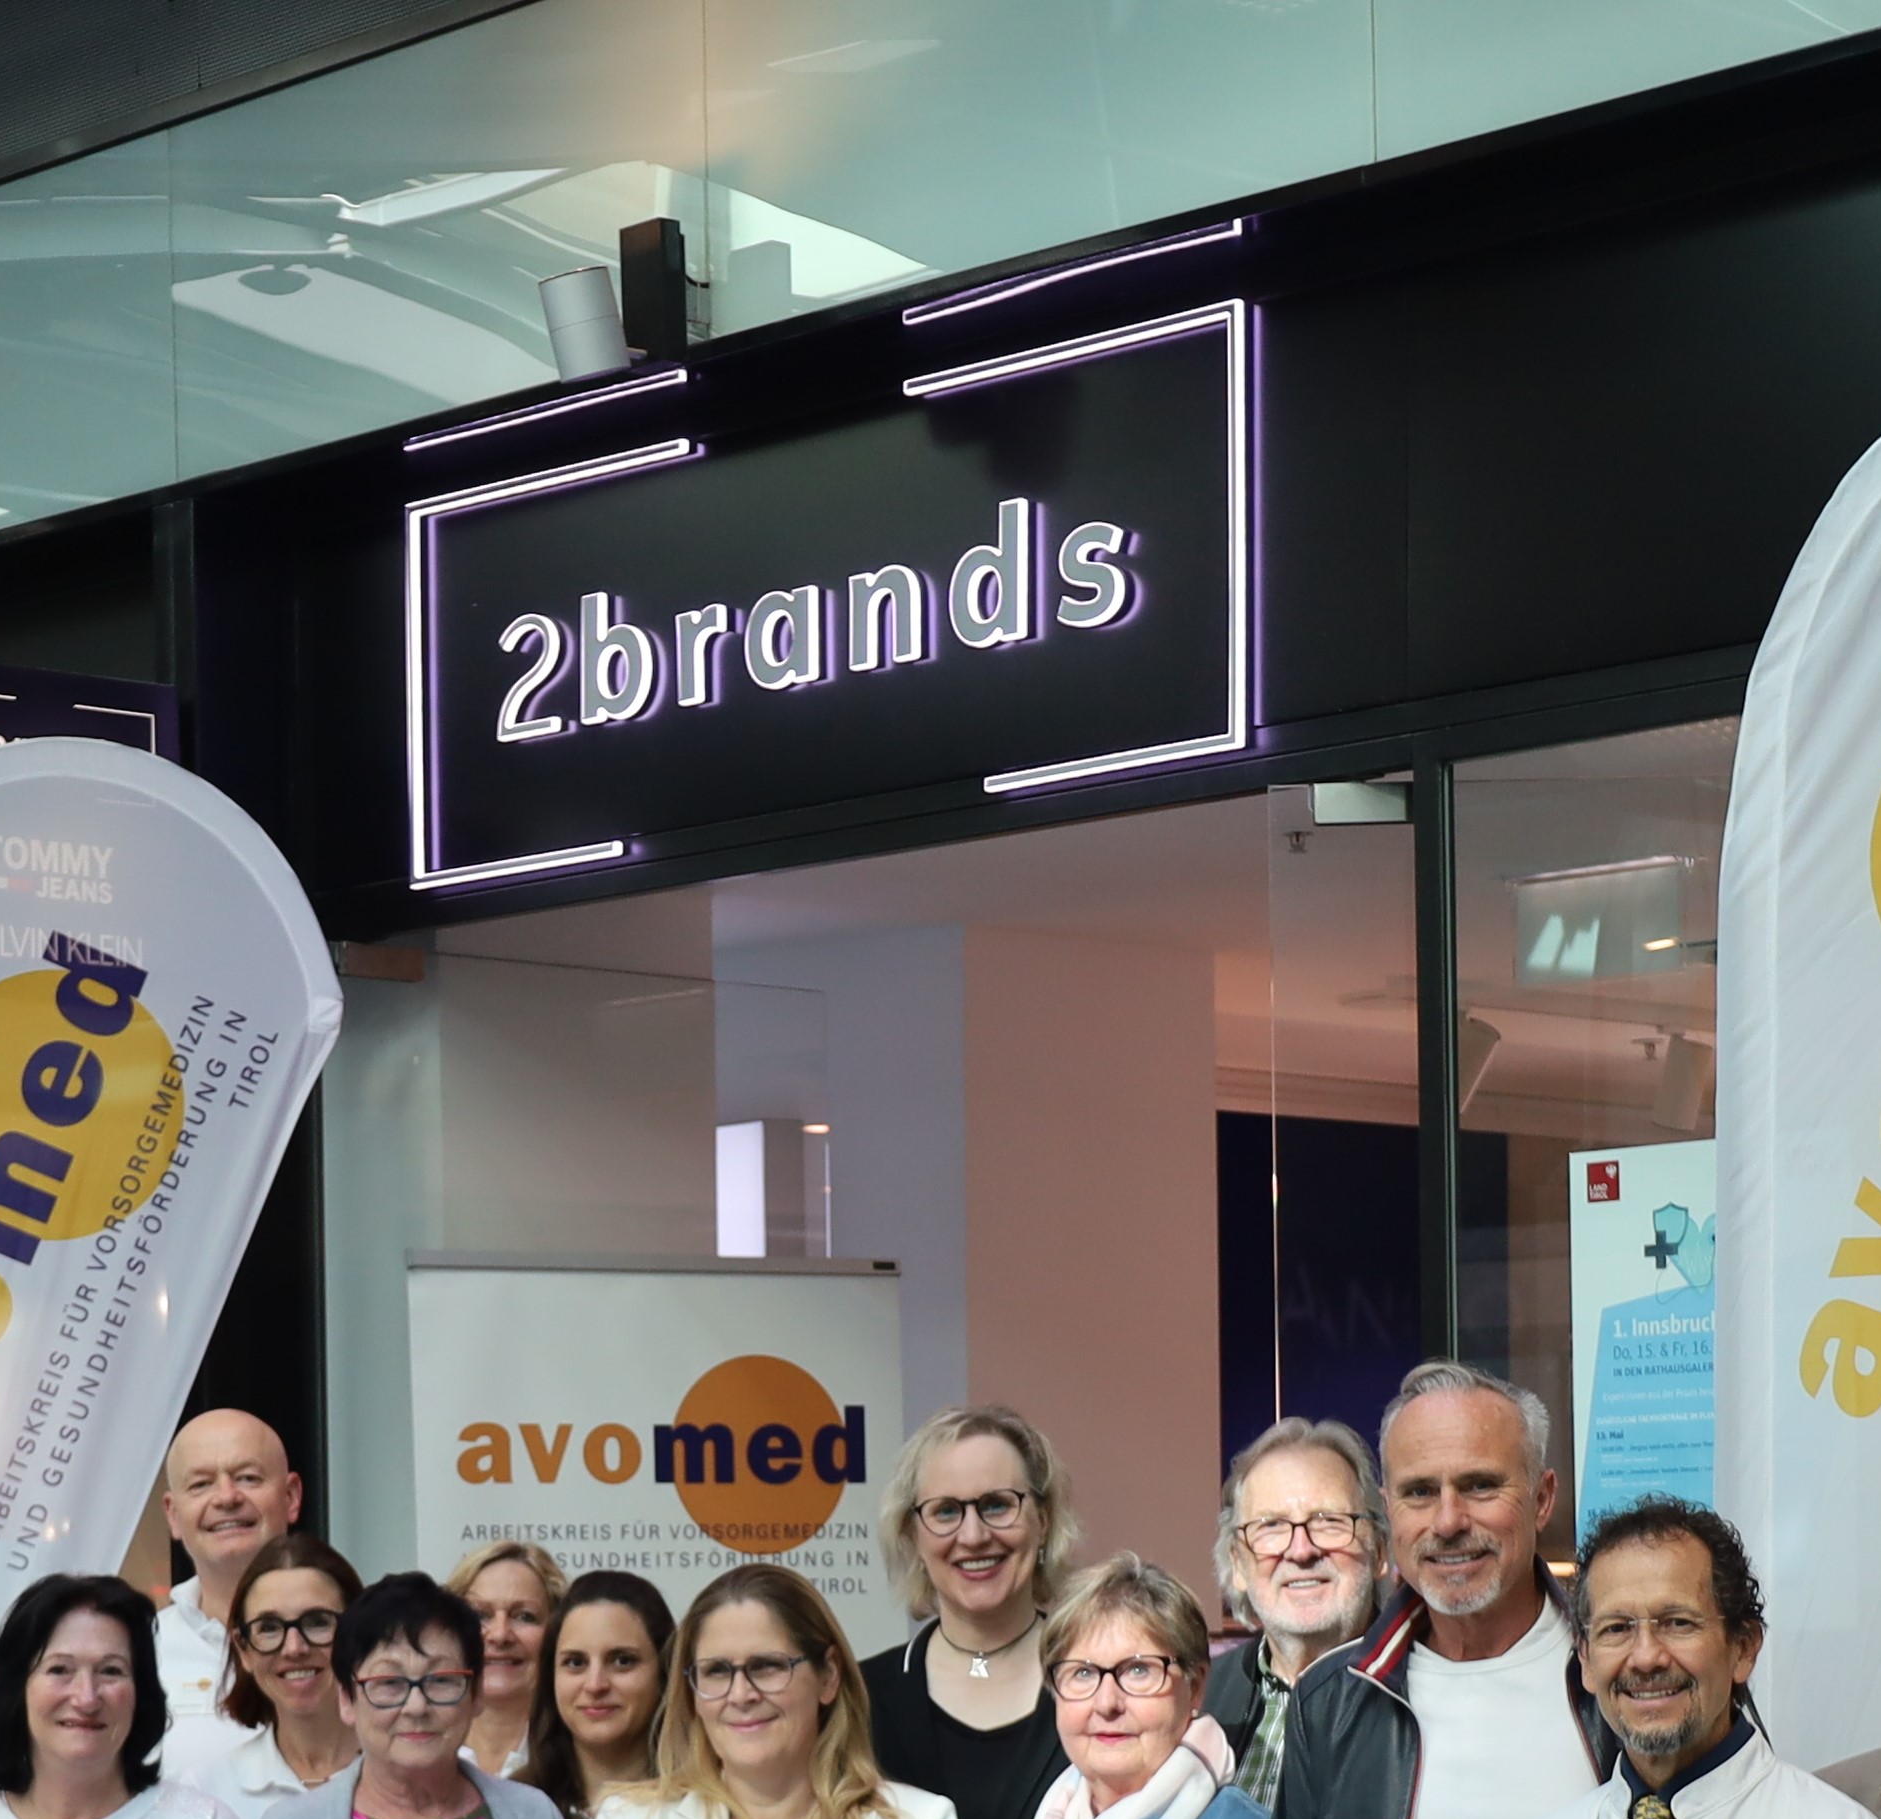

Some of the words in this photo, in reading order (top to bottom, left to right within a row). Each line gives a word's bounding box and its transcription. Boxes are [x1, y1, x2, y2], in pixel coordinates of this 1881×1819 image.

[495, 496, 1128, 743] 2brands
[36, 875, 113, 904] JEANS
[66, 931, 144, 968] KLEIN
[228, 1031, 279, 1109] TIROL
[60, 1283, 98, 1341] FÜR
[86, 995, 215, 1273] VORSORGEMEDIZIN
[6, 1502, 50, 1572] UND
[41, 1057, 228, 1487] GESUNDHEITSFÖRDERUNG
[219, 1009, 248, 1045] IN
[1613, 1319, 1628, 1338] 1.
[1612, 1345, 1633, 1361] Do,
[1637, 1343, 1657, 1359] 15.
[1660, 1342, 1669, 1357] &
[1673, 1341, 1688, 1357] Fr,
[456, 1404, 867, 1486] avomed
[461, 1523, 612, 1541] ARBEITSKREIS
[620, 1519, 661, 1541] FÜR
[669, 1523, 869, 1541] VORSORGEMEDIZIN
[846, 1550, 869, 1568] IN
